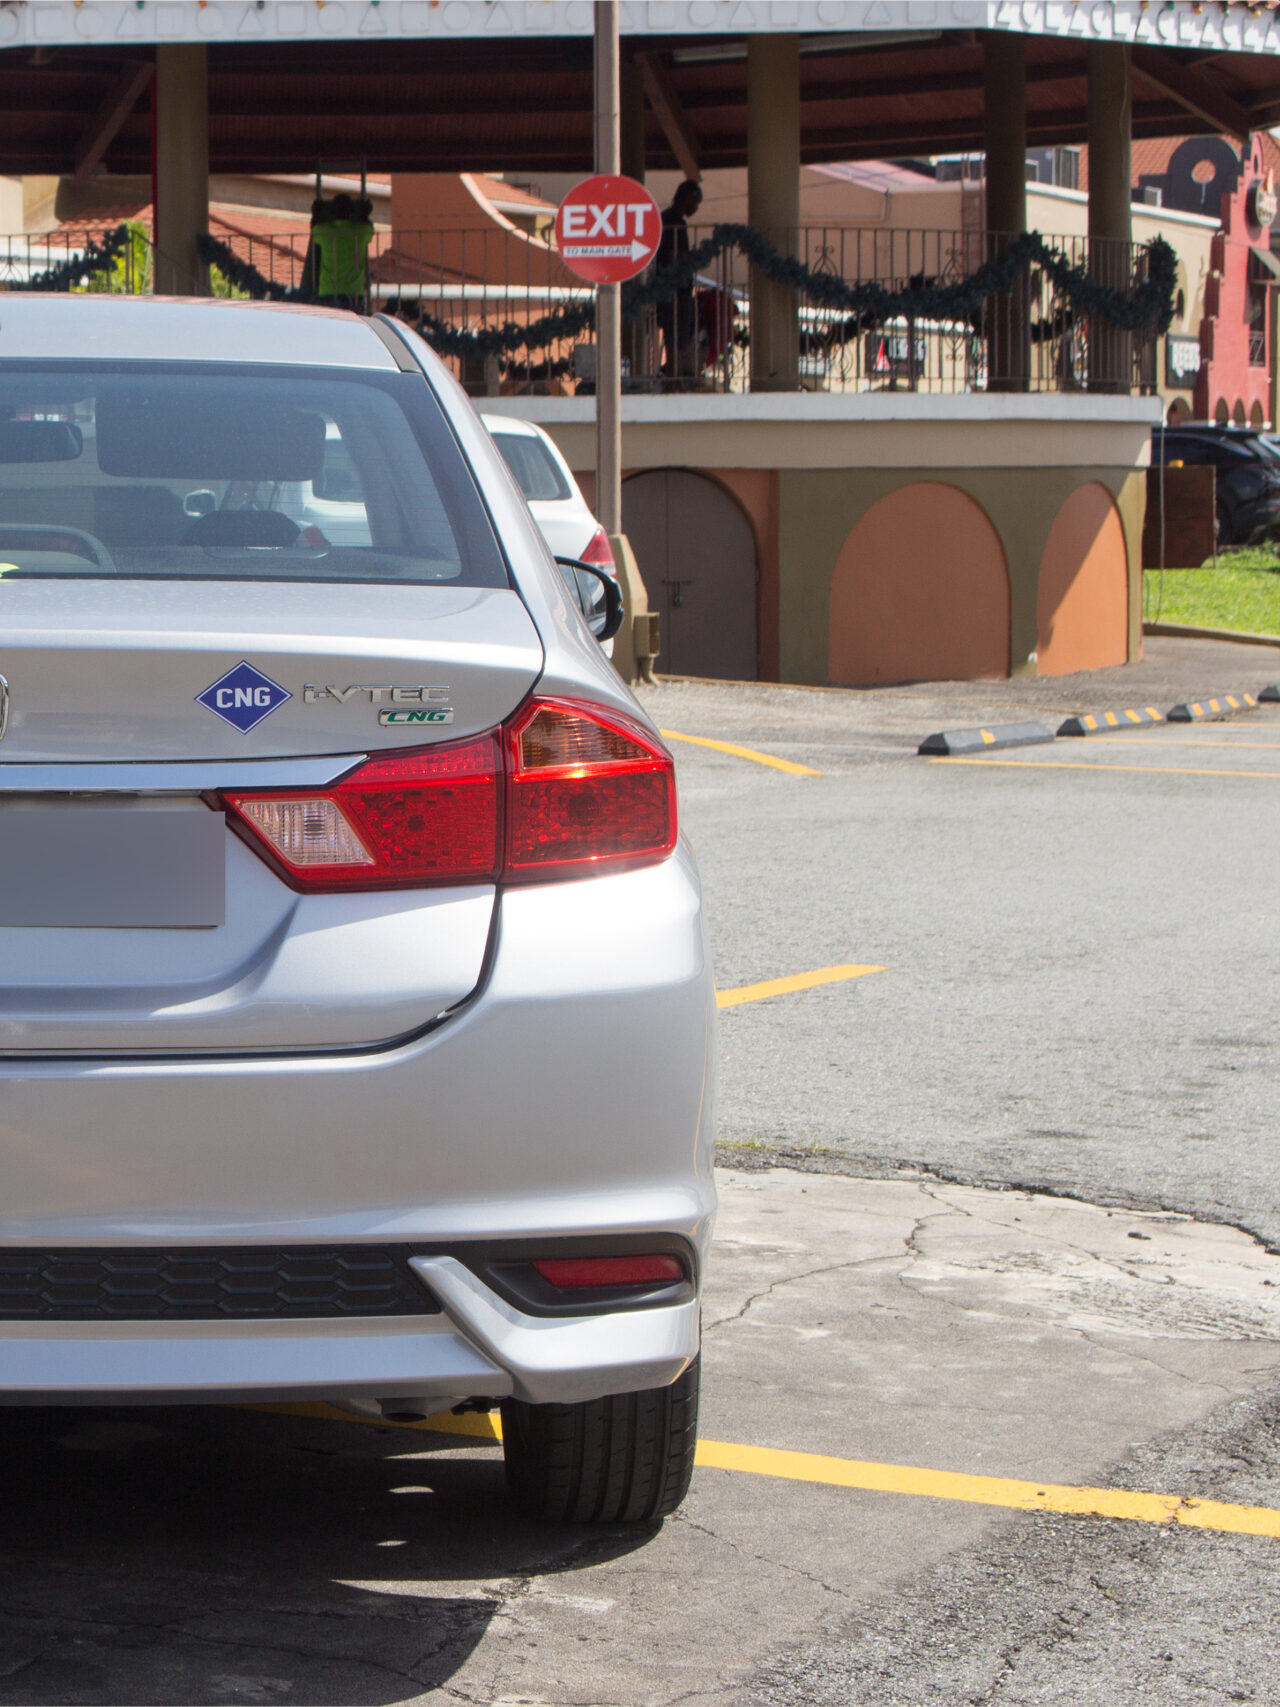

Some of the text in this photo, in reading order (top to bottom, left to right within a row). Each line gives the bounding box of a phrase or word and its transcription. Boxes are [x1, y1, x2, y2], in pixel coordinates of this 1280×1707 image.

[563, 204, 652, 238] EXIT
[566, 247, 579, 255] TO
[607, 246, 632, 254] GATE
[216, 687, 270, 708] CNG
[387, 711, 447, 722] CNG
